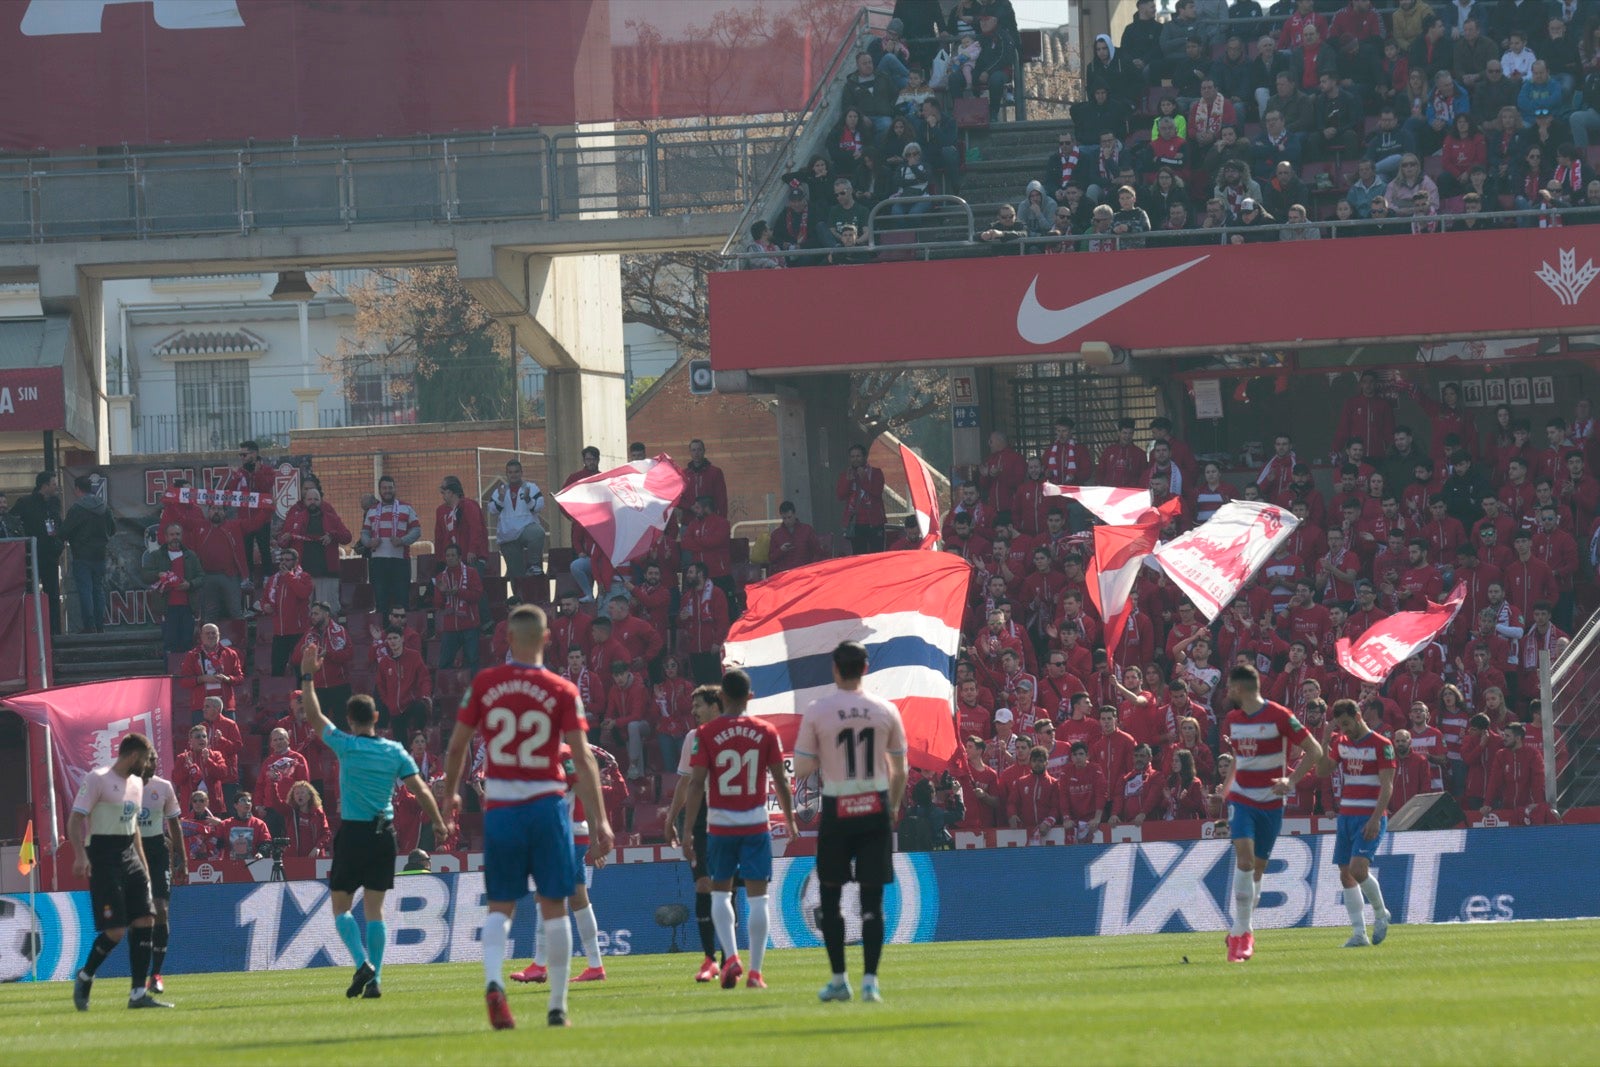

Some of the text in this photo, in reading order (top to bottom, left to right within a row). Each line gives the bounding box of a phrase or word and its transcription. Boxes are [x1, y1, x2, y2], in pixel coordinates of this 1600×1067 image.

[18, 386, 38, 400] SIN
[481, 680, 548, 707] DOMINGOS
[486, 707, 552, 768] 22
[714, 726, 764, 745] HERRERA
[836, 727, 875, 779] 11
[716, 749, 760, 795] 21
